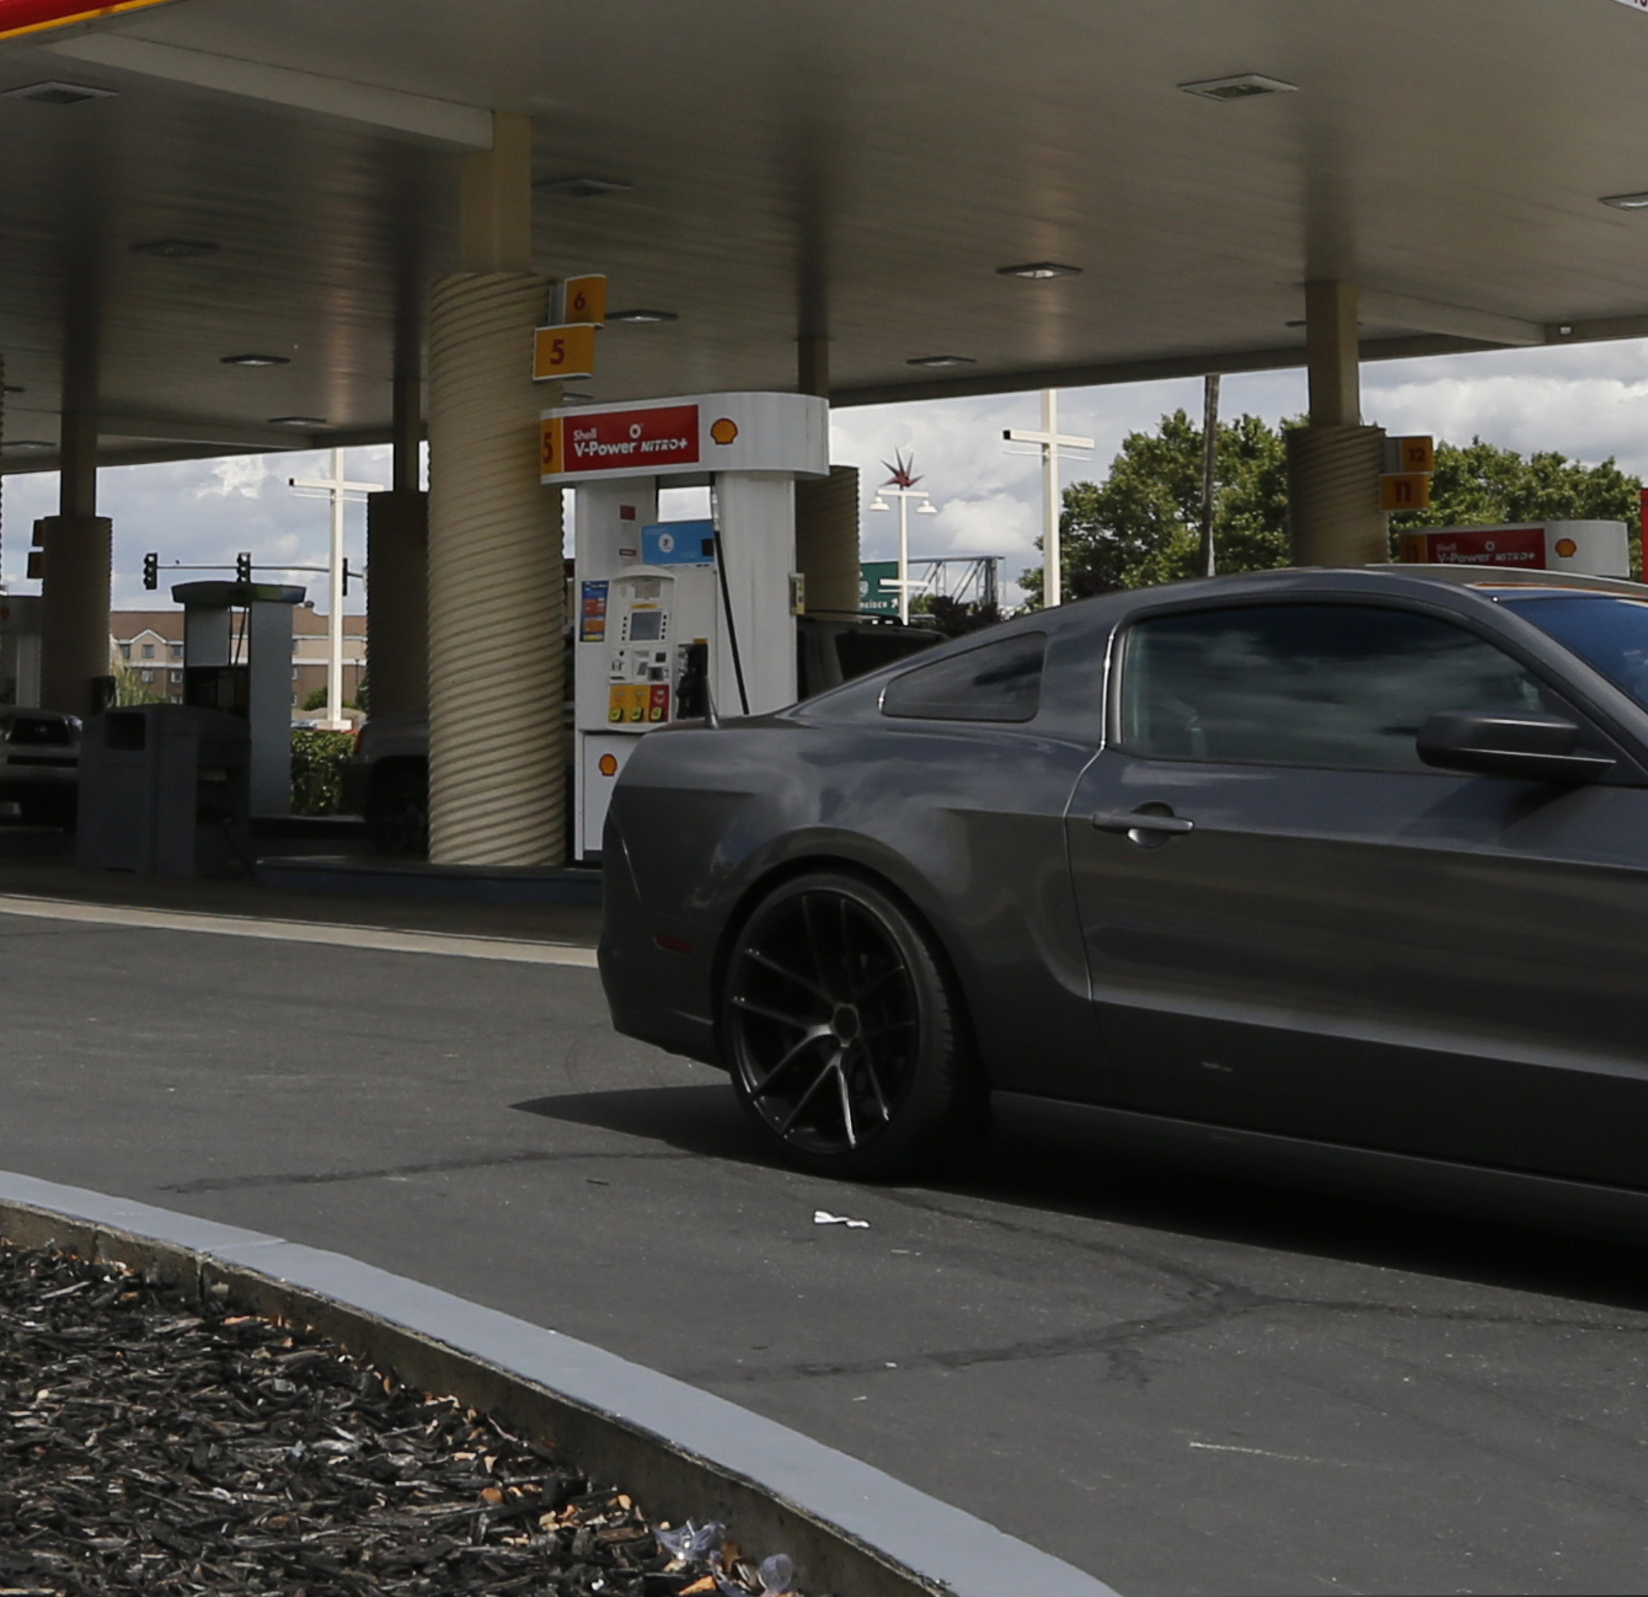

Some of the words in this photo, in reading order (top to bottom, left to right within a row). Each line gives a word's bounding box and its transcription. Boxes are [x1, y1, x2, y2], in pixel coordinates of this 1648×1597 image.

[573, 290, 587, 311] 6
[550, 338, 566, 366] 5
[573, 428, 598, 441] Shell
[573, 439, 638, 458] V-Power
[1410, 447, 1426, 463] 12
[1393, 480, 1413, 504] 11
[1436, 551, 1491, 564] V-Power
